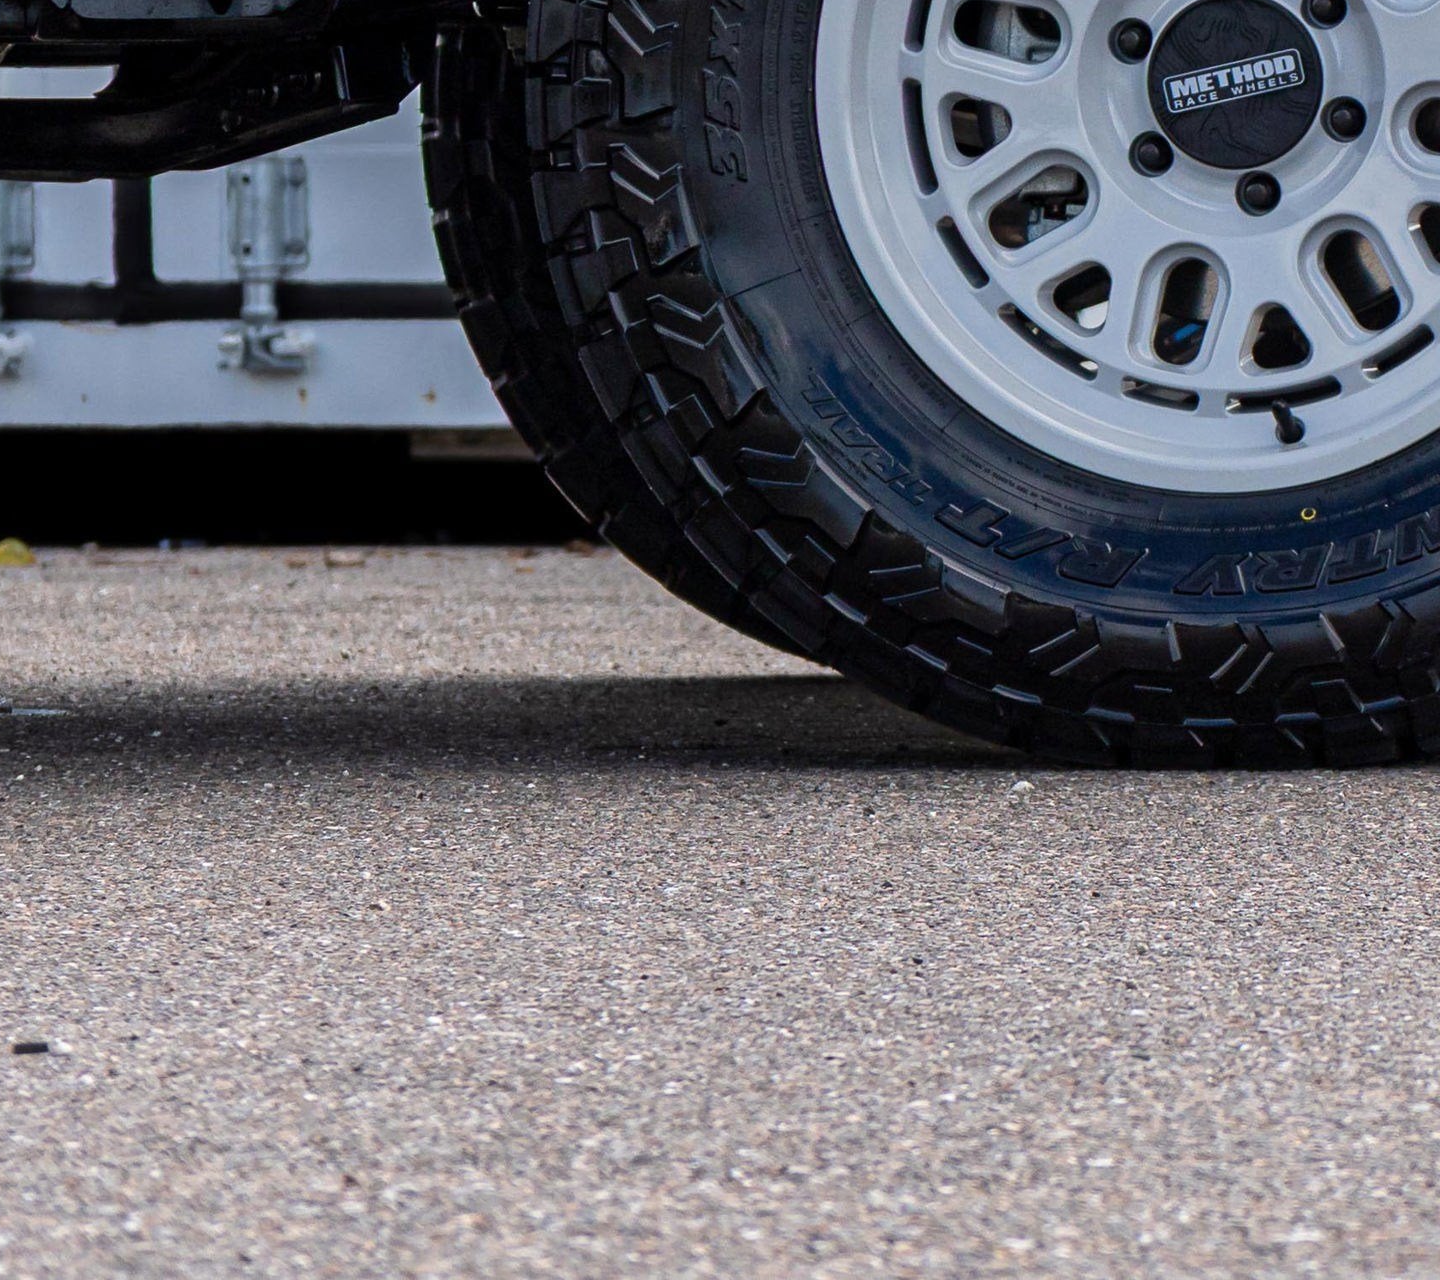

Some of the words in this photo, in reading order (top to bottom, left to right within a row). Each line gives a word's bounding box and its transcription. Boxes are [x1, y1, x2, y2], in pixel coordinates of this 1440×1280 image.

[1169, 54, 1296, 100] METHOD
[1173, 90, 1219, 110] RACE
[1230, 72, 1299, 96] WHEELS
[932, 497, 1150, 589] R/T
